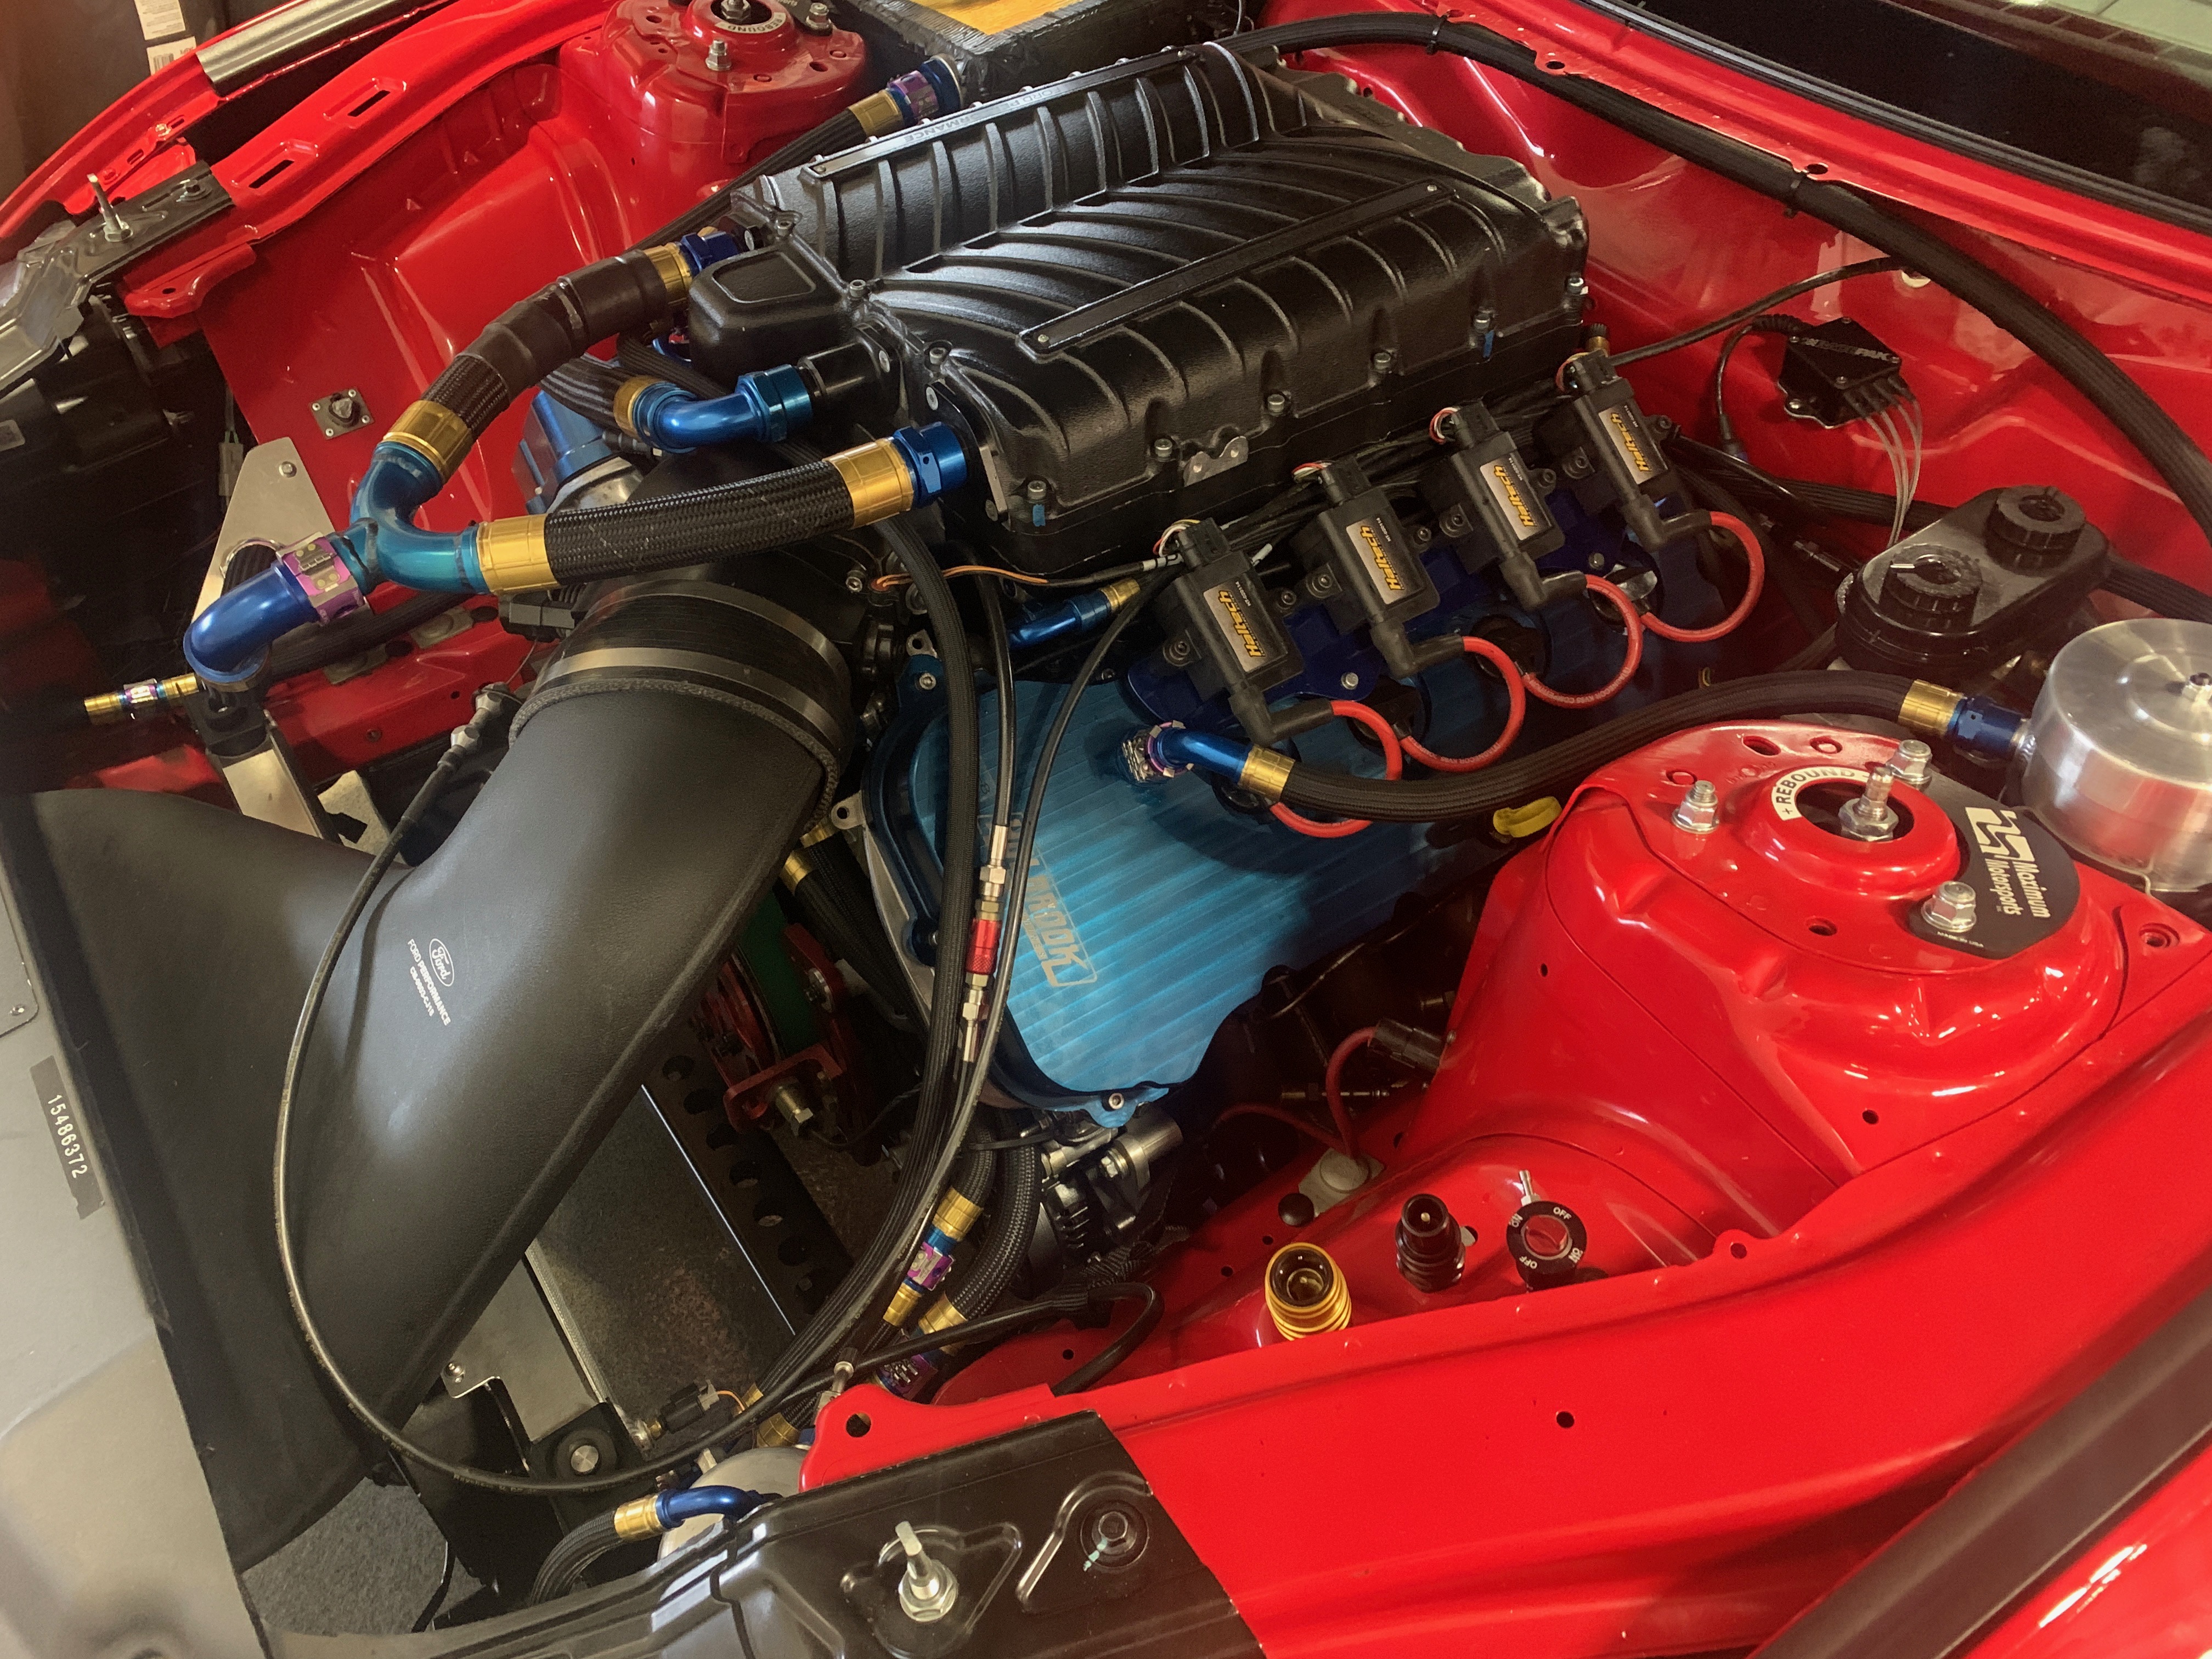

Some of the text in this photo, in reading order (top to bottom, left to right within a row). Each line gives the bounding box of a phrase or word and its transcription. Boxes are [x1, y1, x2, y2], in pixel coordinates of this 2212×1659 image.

[728, 18, 783, 33] REBOUND
[904, 87, 1062, 142] FORD PERMANCE
[1611, 413, 1649, 471] Haltech
[1494, 465, 1535, 527] Haltech
[1360, 526, 1402, 590] Haltech
[1218, 590, 1263, 657] Haltech
[1776, 768, 1855, 804] REBOUND
[1985, 858, 2024, 916] Motorsports
[2012, 861, 2051, 917] Maximum
[408, 939, 451, 1025] FORD PERFORMANCE
[431, 945, 452, 981] Ford
[48, 1094, 88, 1178] 15486372
[1510, 1213, 1523, 1228] ON
[1553, 1206, 1572, 1220] OFF
[1519, 1256, 1538, 1269] OFF
[1568, 1247, 1582, 1263] ON
